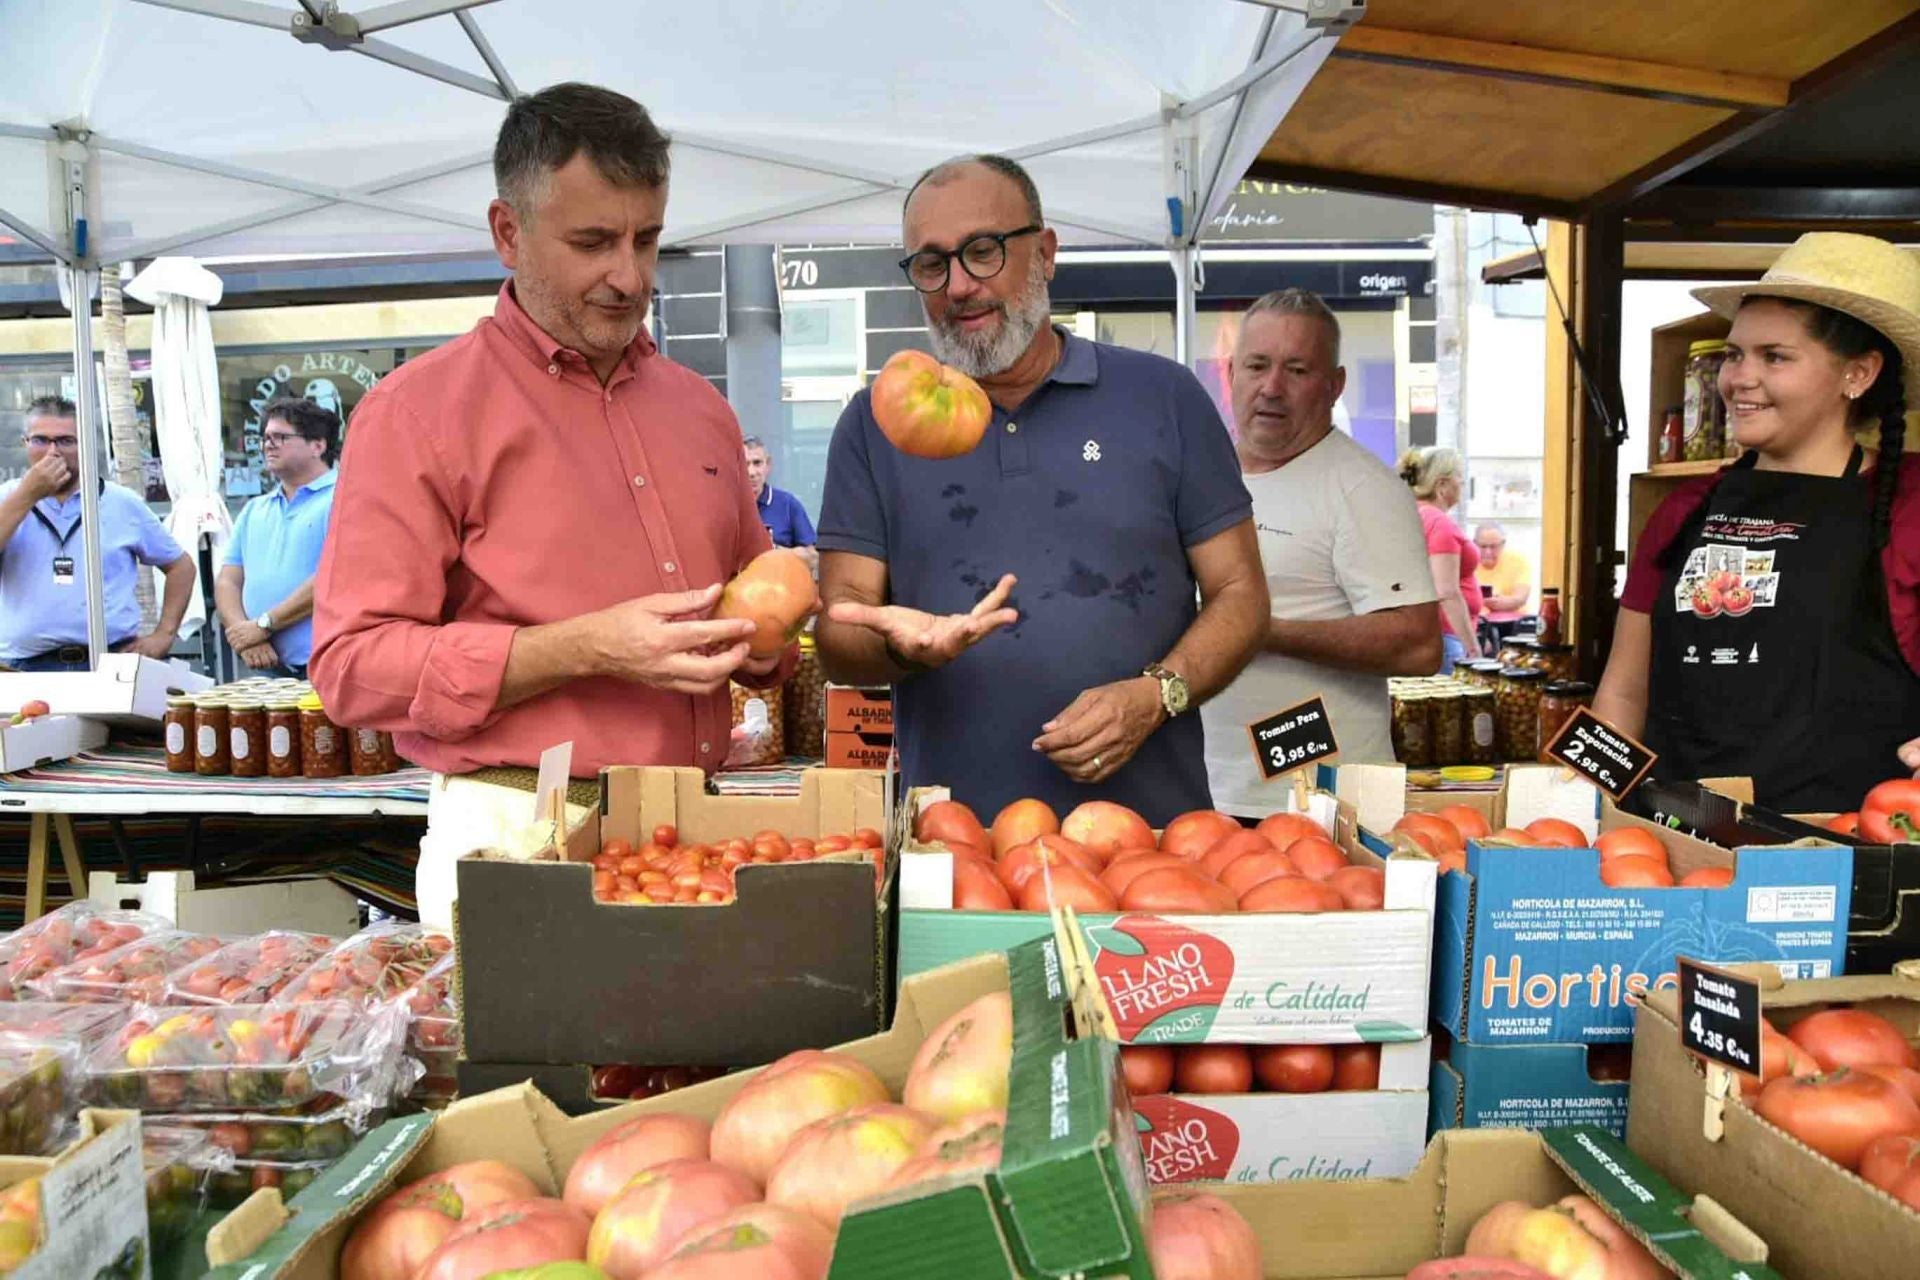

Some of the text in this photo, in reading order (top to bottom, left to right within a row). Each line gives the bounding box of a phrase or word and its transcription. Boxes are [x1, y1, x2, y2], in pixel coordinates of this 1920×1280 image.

[1359, 272, 1406, 290] origen
[1259, 711, 1320, 740] Tomate Pera
[1593, 725, 1631, 754] Tomate
[1270, 746, 1305, 767] 3.95
[1563, 740, 1600, 773] 2.95
[1575, 727, 1634, 771] Exportación
[1512, 899, 1560, 909] HORTICOLA
[1562, 898, 1575, 908] DE
[1515, 931, 1558, 941] MAZARRON
[1566, 931, 1597, 940] MURCIA
[1603, 929, 1634, 940] ESPAÑA
[1100, 943, 1202, 998] LLANO
[1112, 965, 1213, 1021] FRESH
[1234, 980, 1371, 1011] de Calidad
[1696, 973, 1737, 999] Tomate
[1694, 990, 1741, 1019] Ensalada
[1150, 1012, 1205, 1042] TRADE
[1488, 1018, 1552, 1026] TOMATES DE
[1490, 1027, 1548, 1035] MAZARRON
[1583, 1027, 1630, 1035] PRODUCIDO
[1689, 1011, 1724, 1052] 4.35
[1500, 1099, 1549, 1109] HORTICOLA
[1551, 1099, 1562, 1108] DE
[1574, 1132, 1613, 1165] TOMATE
[1237, 1156, 1372, 1182] de Calidad
